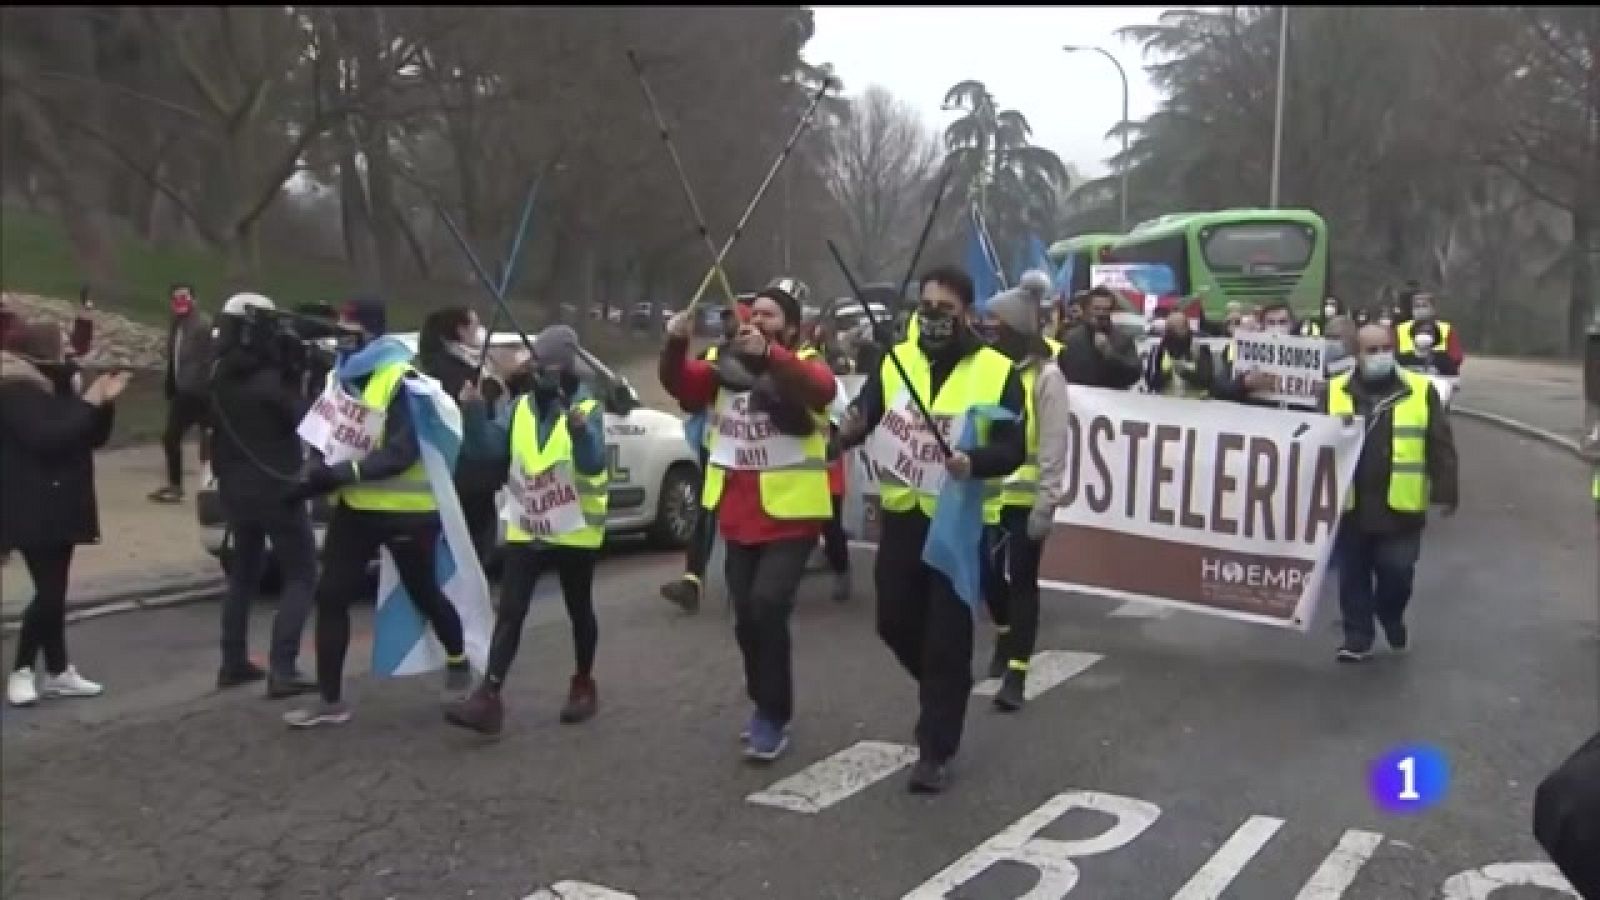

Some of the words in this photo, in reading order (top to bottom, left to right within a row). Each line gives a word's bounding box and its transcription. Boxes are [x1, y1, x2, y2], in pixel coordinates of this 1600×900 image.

[1236, 340, 1276, 365] TODOS
[1278, 345, 1321, 371] SOMOS
[1053, 411, 1338, 544] OSTELERÍA
[899, 789, 1582, 900] BU
